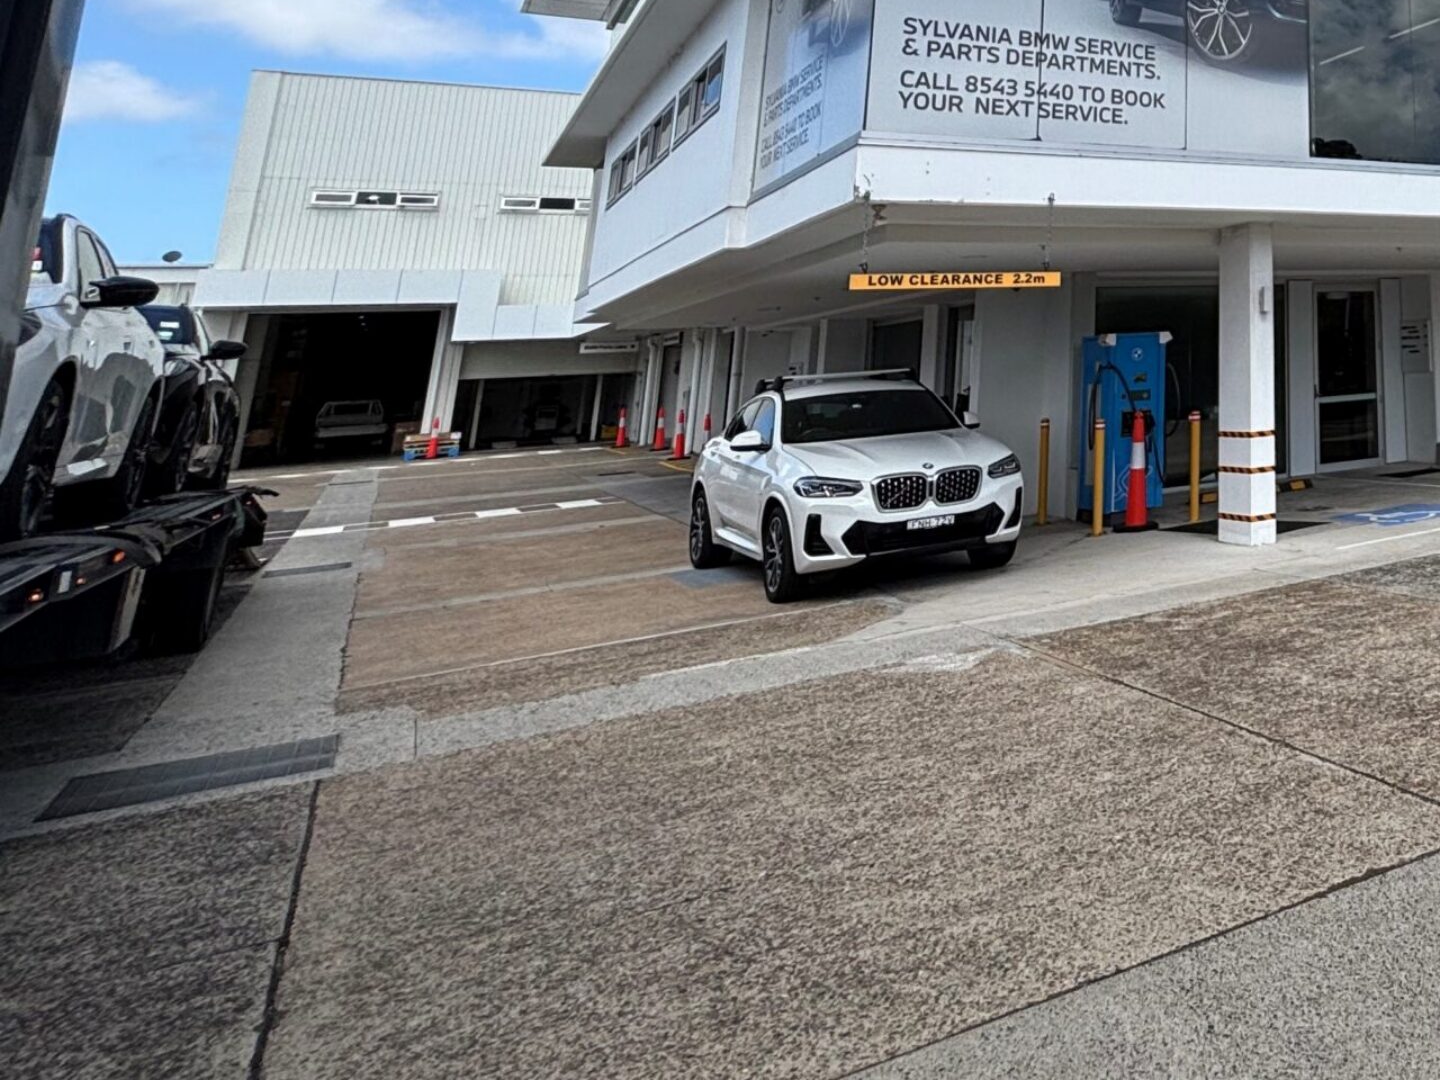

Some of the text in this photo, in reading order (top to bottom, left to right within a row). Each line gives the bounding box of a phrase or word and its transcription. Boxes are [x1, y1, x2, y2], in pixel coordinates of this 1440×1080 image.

[903, 17, 1156, 61] SYLVANIA BMW SERVICE
[902, 38, 1161, 80] & PARTS DEPARTMENTS.
[898, 90, 1128, 125] YOUR NEXT SERVICE.
[900, 70, 1166, 109] CALL 8543 5440 TO BOOK
[868, 273, 1046, 286] LOW CLEARANCE 2.2m
